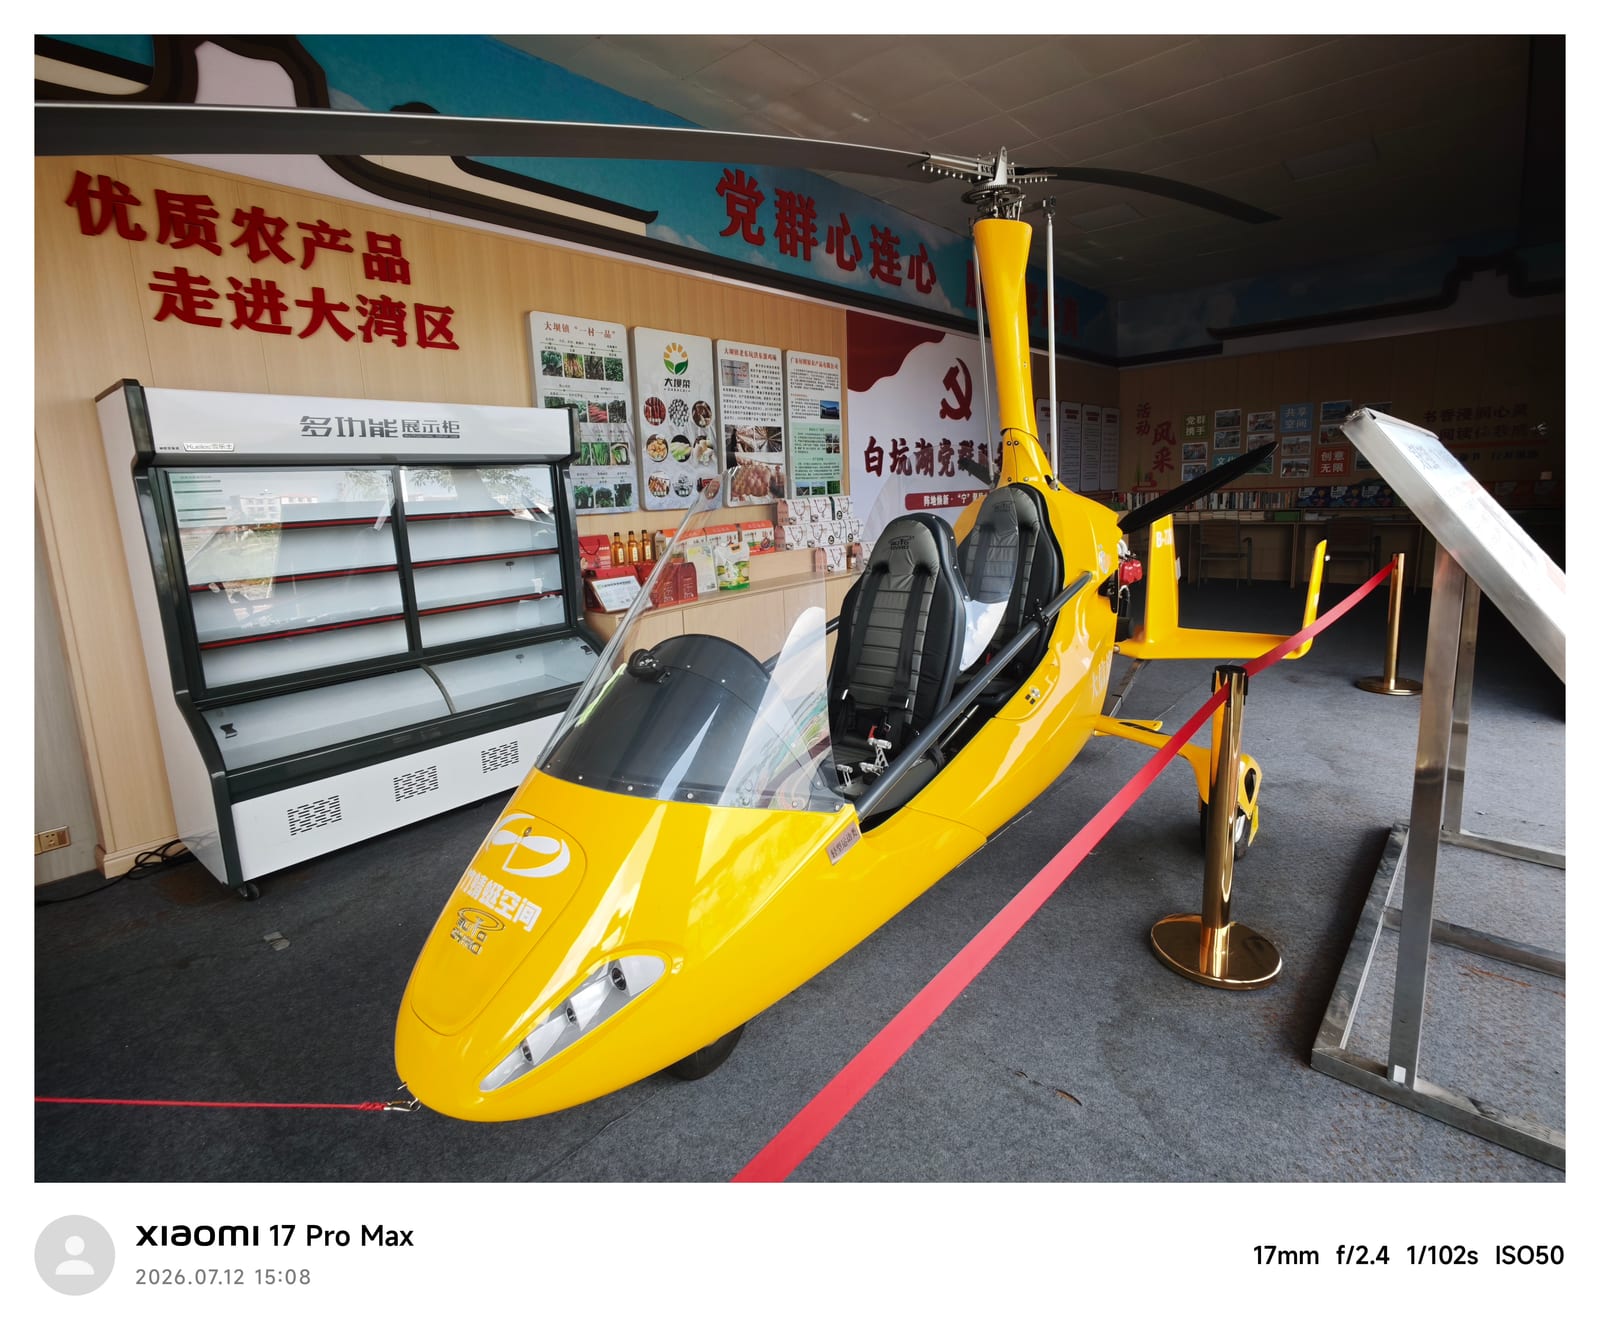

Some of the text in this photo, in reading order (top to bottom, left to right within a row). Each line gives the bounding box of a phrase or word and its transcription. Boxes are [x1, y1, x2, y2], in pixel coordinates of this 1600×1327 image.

[65, 170, 412, 286] 优质农产品
[715, 168, 937, 294] 党群心连心
[148, 266, 461, 351] 走进大湾区
[664, 377, 690, 389] 大坝菜
[299, 415, 461, 438] 多功能展示柜
[1136, 402, 1151, 436] 活动
[1185, 415, 1206, 426] 党群
[1286, 407, 1307, 418] 共享
[864, 435, 1003, 478] 白坑湖党群
[1152, 420, 1176, 473] 风采
[1321, 450, 1345, 462] 创意
[1320, 463, 1345, 473] 无限
